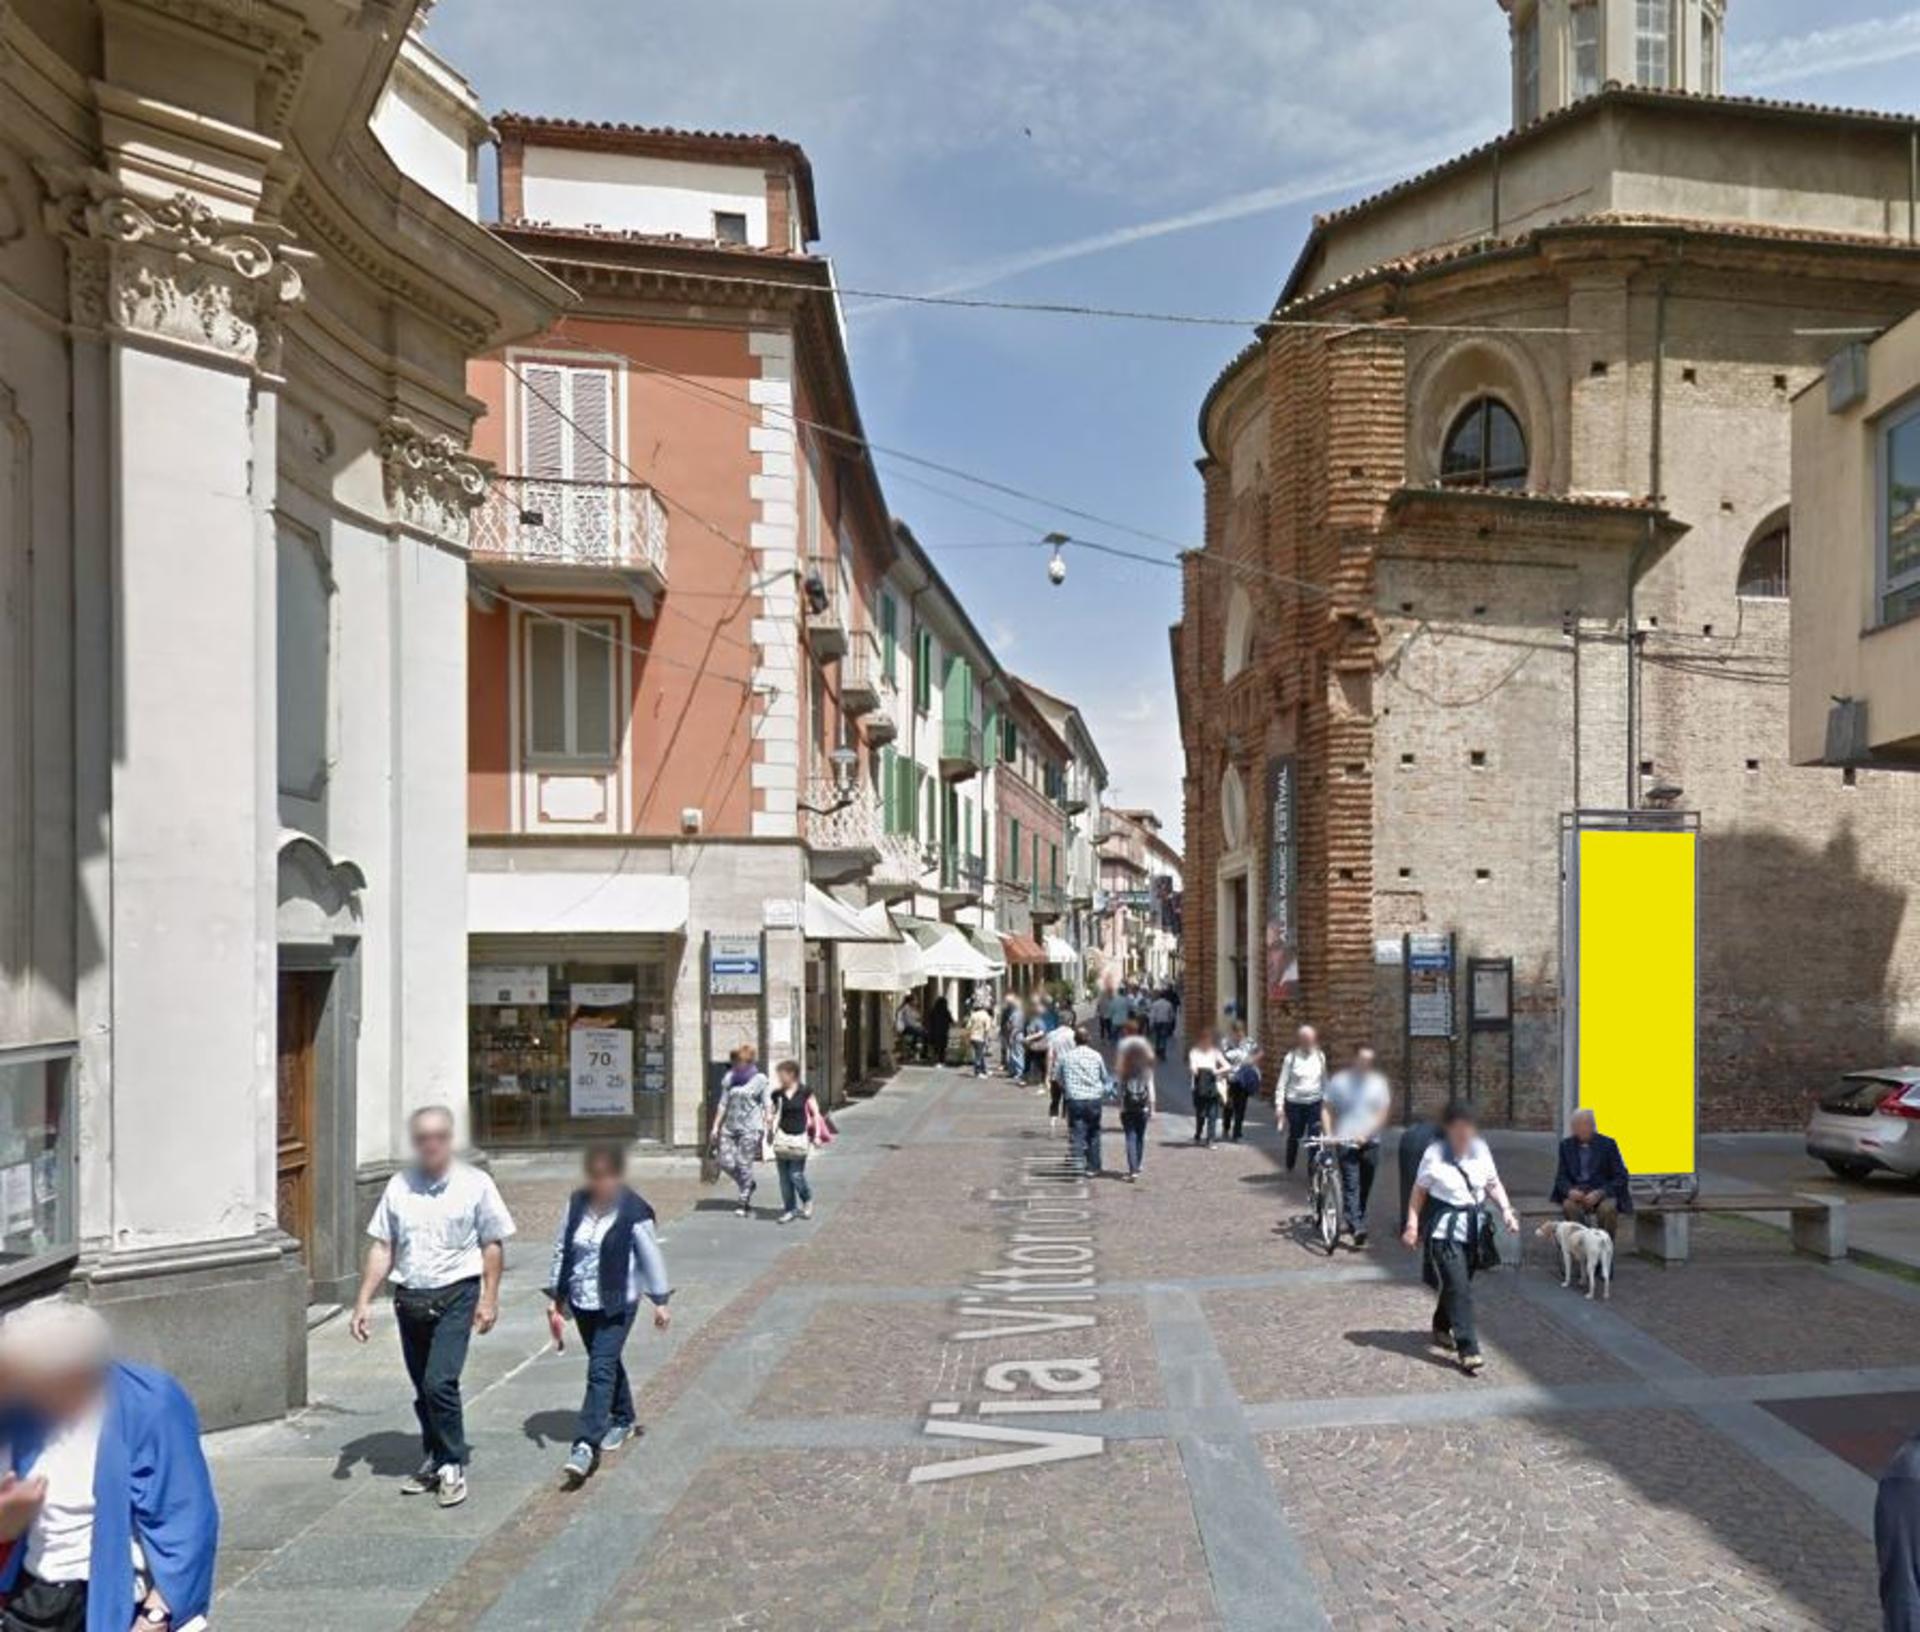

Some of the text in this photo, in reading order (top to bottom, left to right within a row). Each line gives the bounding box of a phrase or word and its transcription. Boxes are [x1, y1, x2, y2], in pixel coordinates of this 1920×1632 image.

[1278, 764, 1287, 942] ALBA MUSIC FESTIVAL
[588, 1051, 612, 1067] 70
